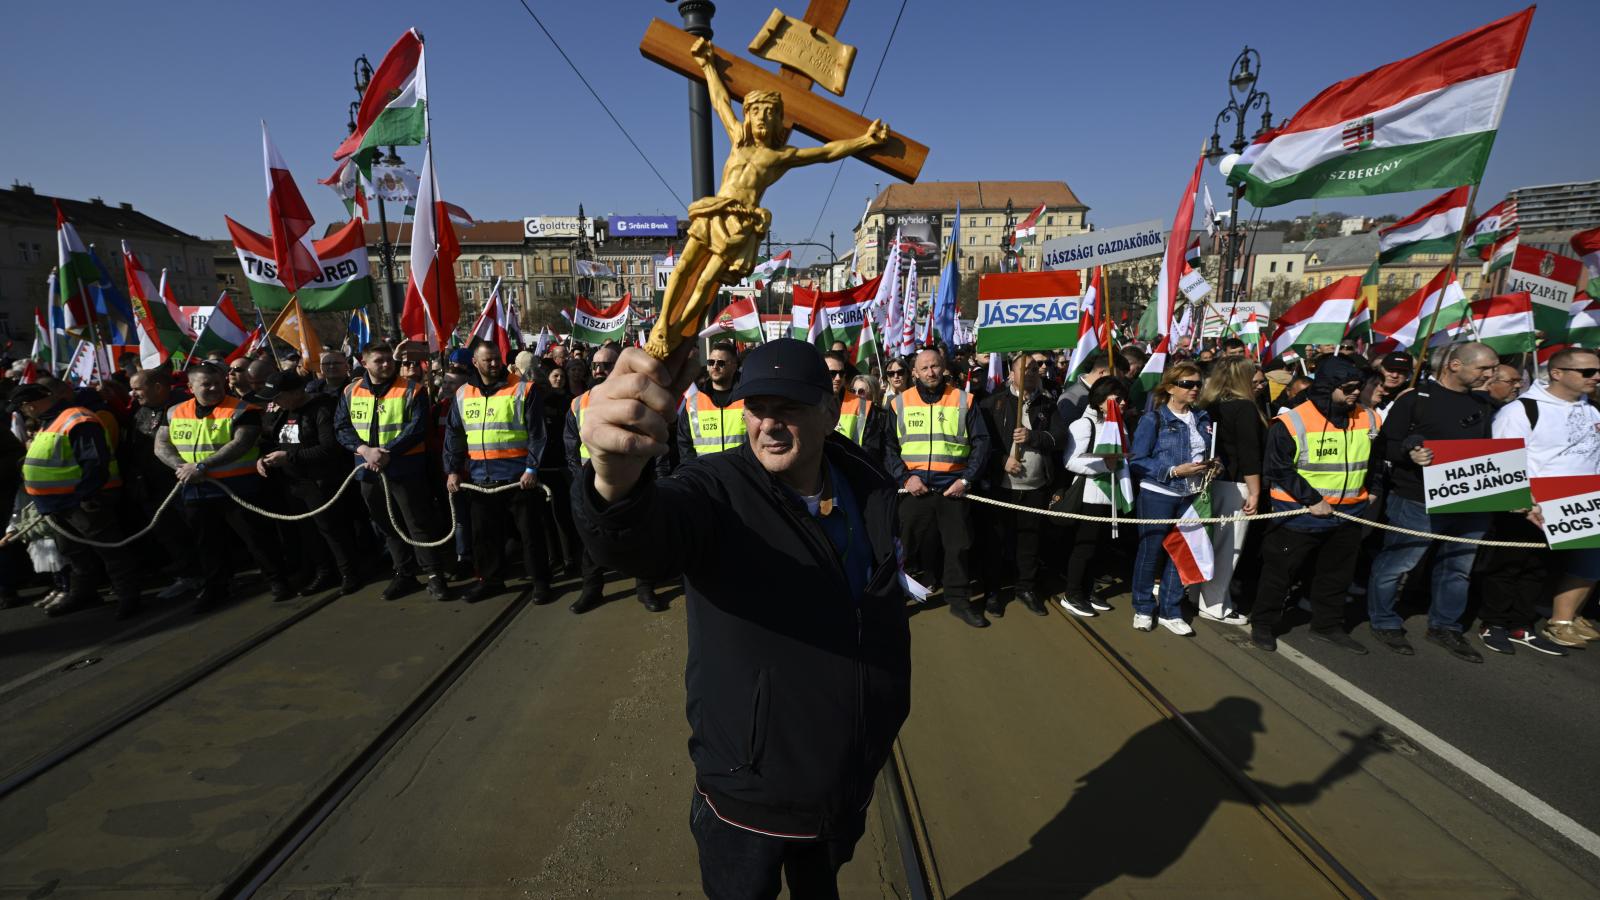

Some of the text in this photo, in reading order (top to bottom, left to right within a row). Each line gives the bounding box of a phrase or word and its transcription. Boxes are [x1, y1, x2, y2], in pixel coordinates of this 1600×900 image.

[1328, 158, 1403, 180] SZBERÉNY
[539, 221, 593, 232] goldtresor
[650, 221, 670, 230] Bank
[897, 215, 929, 226] Hybrid+
[1045, 230, 1162, 267] JÁSZSÁGI GAZDAKÖRÖK
[243, 256, 358, 284] TISRED
[1510, 276, 1569, 304] JÁSZAPÁTI
[979, 299, 1078, 328] JÁSZSÁG
[1221, 305, 1257, 313] KISOROG
[1444, 457, 1501, 482] HAJRÁ,
[1428, 469, 1529, 501] PÓCS JÁNOS!
[1546, 518, 1594, 536] PÓCS
